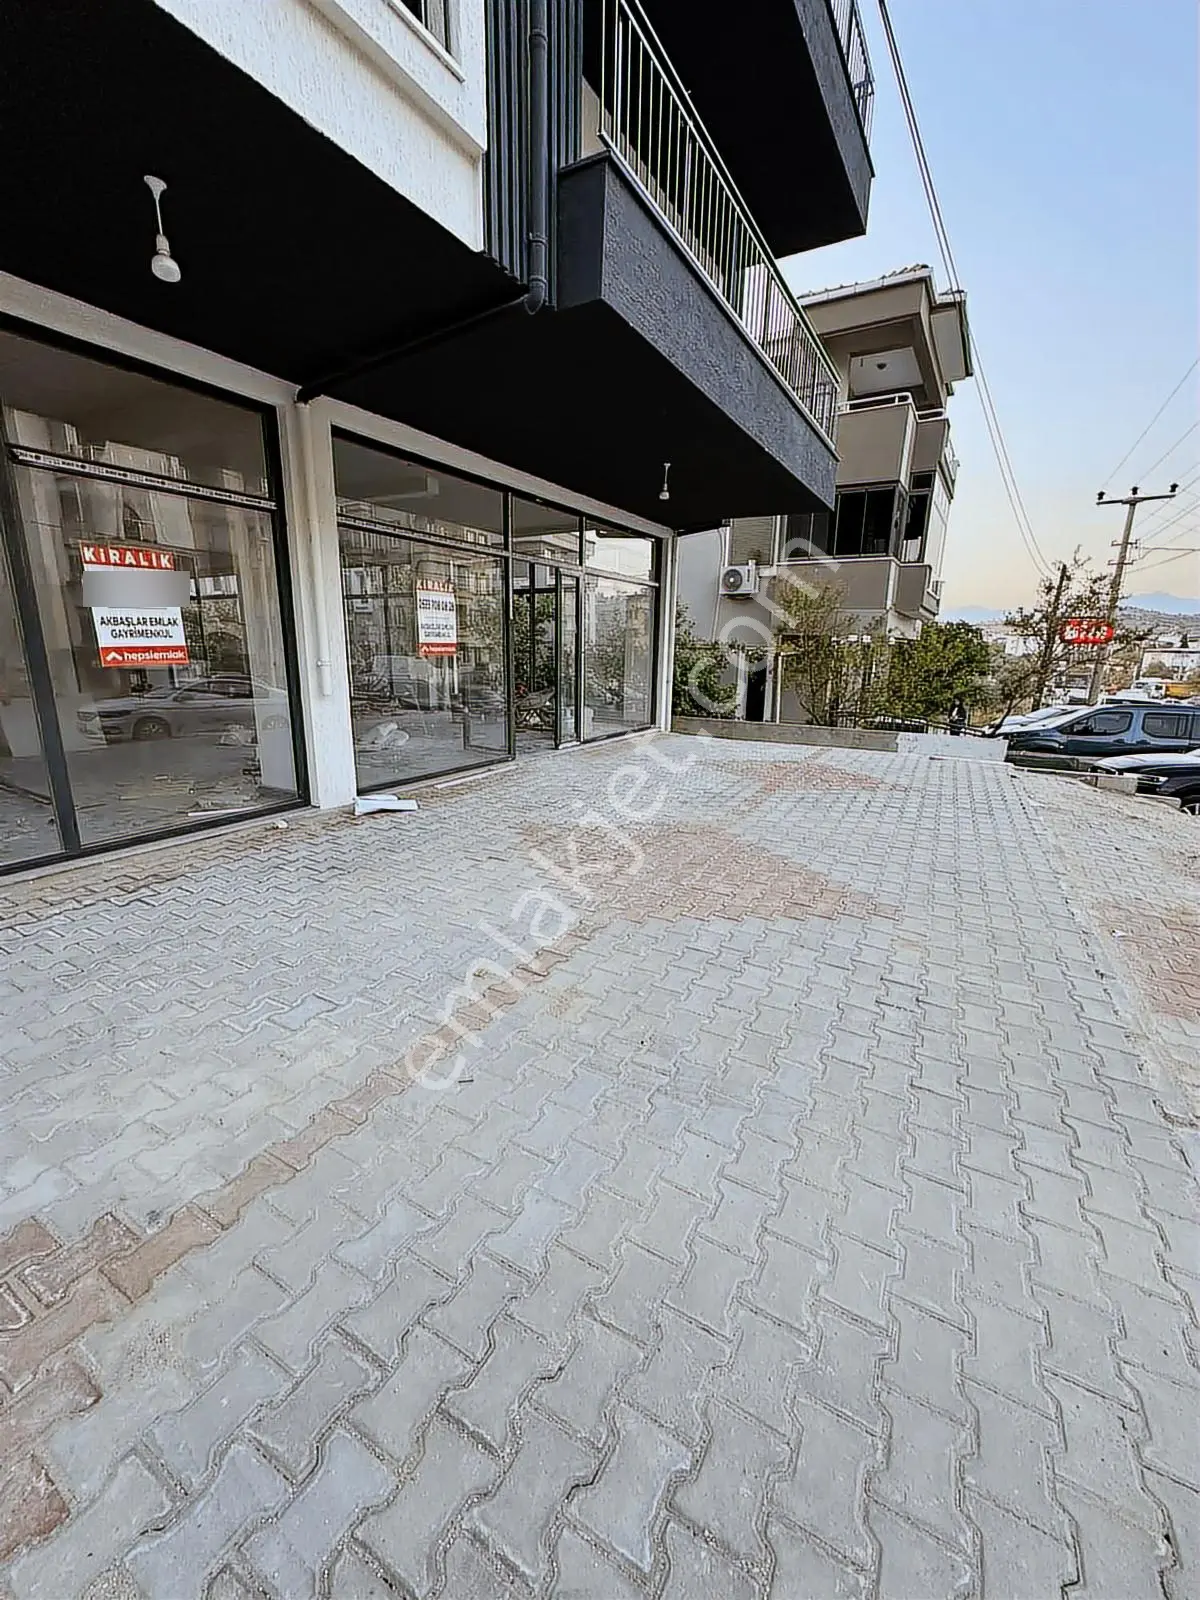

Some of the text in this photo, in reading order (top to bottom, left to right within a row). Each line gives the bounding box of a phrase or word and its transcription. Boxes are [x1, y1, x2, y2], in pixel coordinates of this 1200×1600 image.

[100, 616, 179, 628] AKBAŞLAR EMLAK
[123, 650, 186, 662] hepsiemlak
